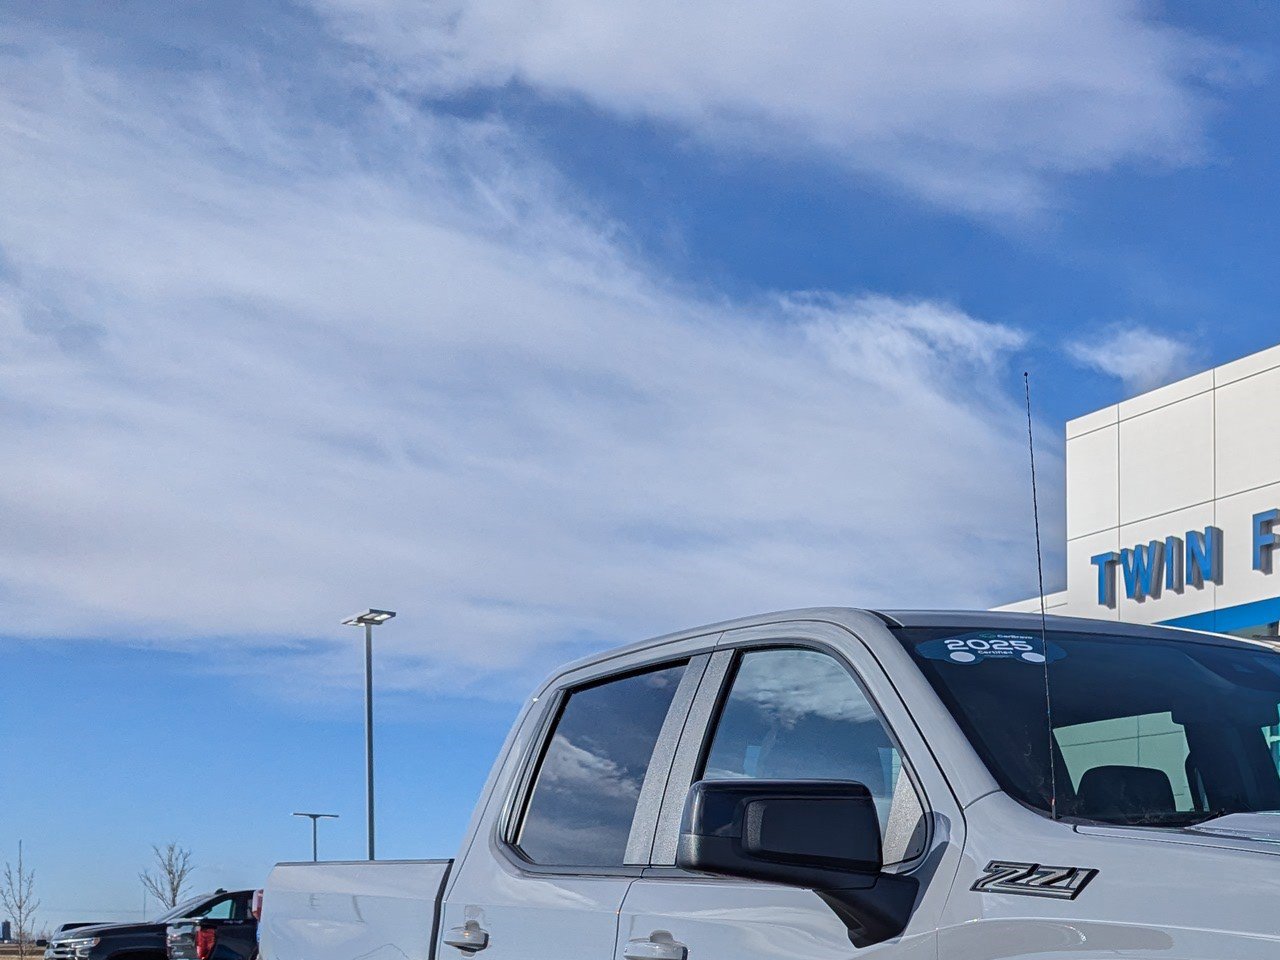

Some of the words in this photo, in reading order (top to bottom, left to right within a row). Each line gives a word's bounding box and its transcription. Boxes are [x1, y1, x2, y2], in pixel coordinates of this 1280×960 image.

[1090, 526, 1223, 610] TWIN
[944, 639, 1033, 651] 2025
[969, 860, 1100, 901] Z71
